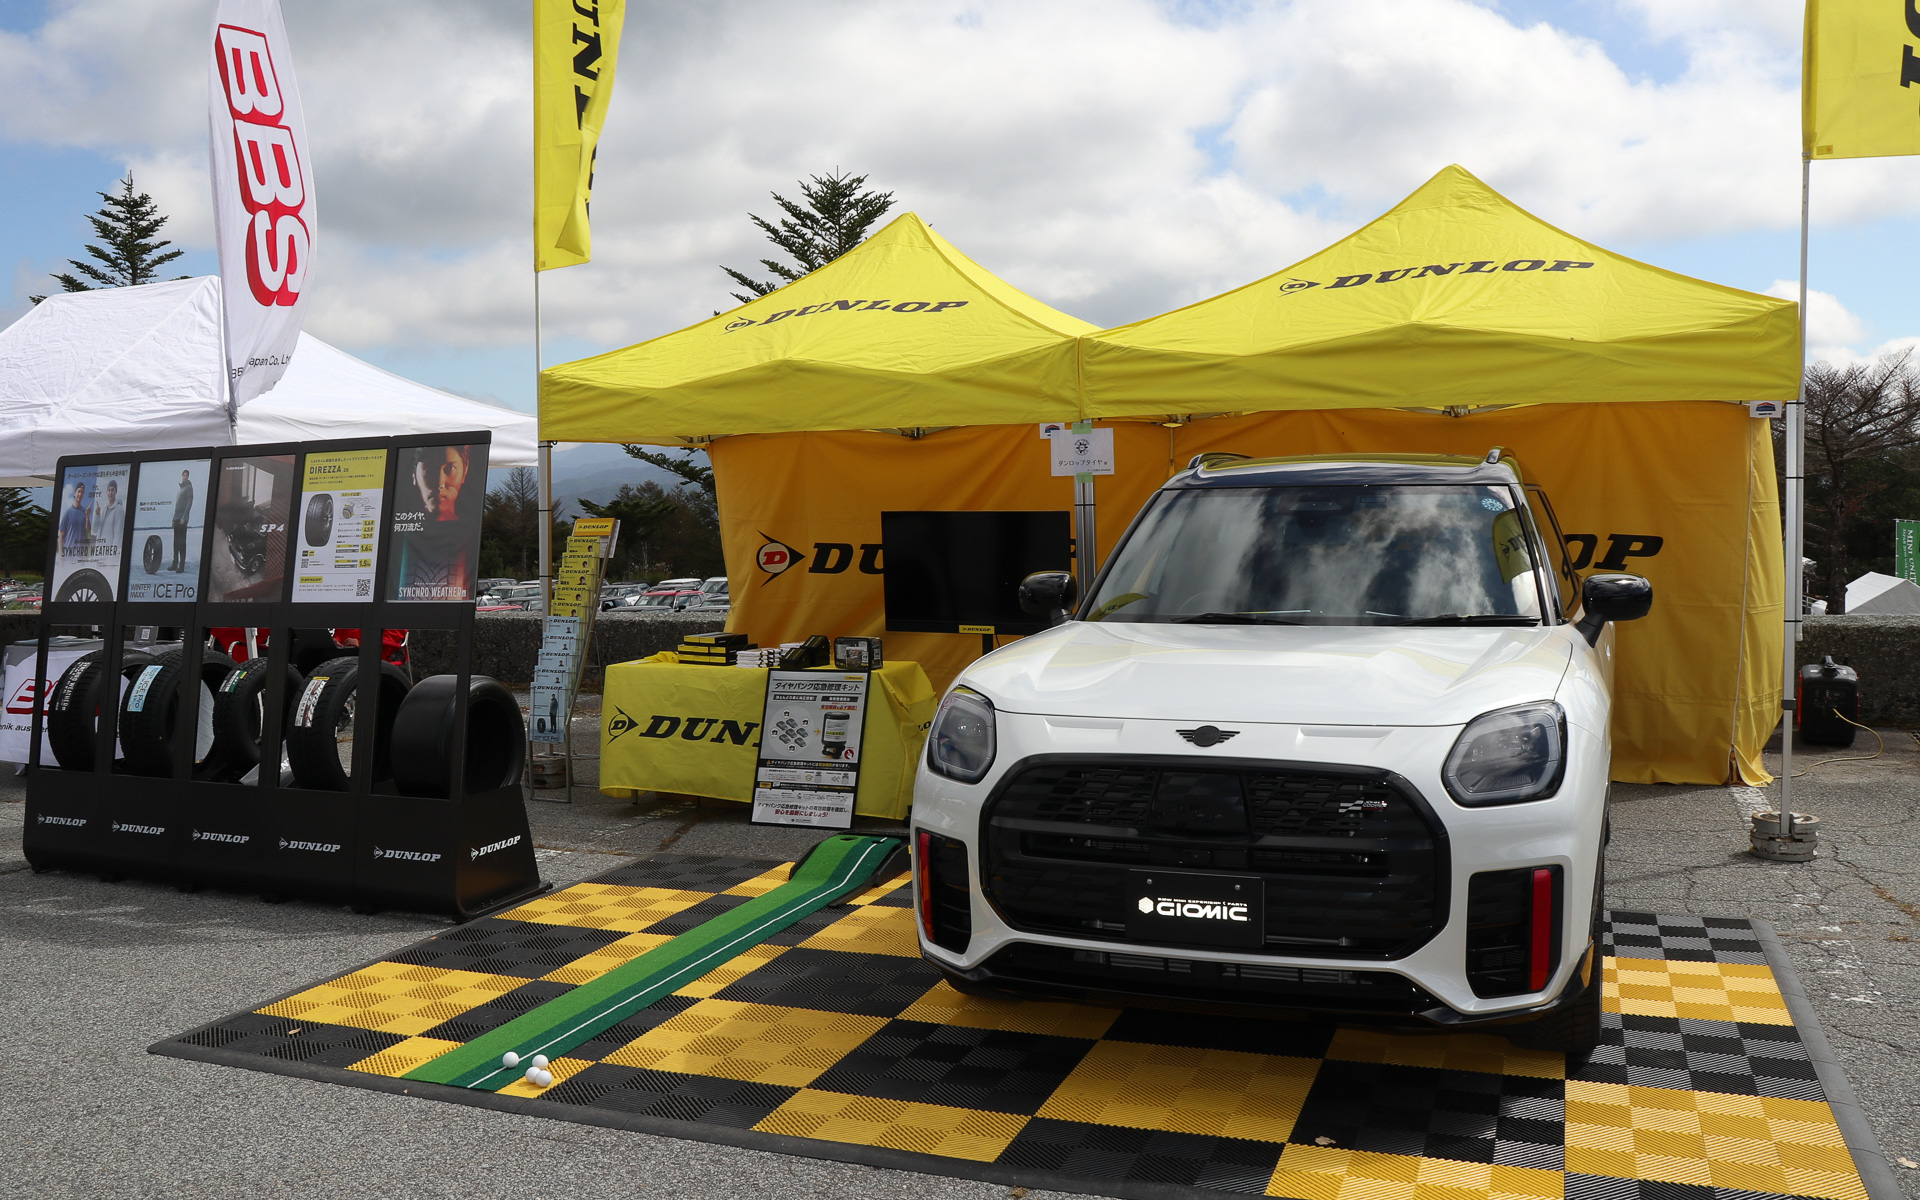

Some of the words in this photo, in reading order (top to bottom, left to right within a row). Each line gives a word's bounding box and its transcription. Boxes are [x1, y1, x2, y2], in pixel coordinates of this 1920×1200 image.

[215, 24, 310, 307] BBS
[1323, 259, 1595, 290] DUNLOP
[756, 299, 969, 327] DUNLOP
[248, 357, 268, 368] apan
[281, 354, 292, 365] Lt
[309, 465, 342, 475] DIREZZA
[259, 523, 285, 533] SP4
[90, 544, 118, 556] WEATHER
[153, 584, 173, 599] ICE
[175, 584, 195, 599] Pro
[398, 586, 429, 598] SYNCHRO
[431, 586, 462, 598] WEATHER
[44, 816, 87, 827] DUNLOP
[119, 823, 165, 836] DUNLOP
[200, 832, 250, 844] DUNLOP
[288, 840, 341, 853] DUNLOP
[478, 834, 521, 857] DUNLOP
[383, 849, 442, 863] DUNLOP
[1156, 901, 1248, 922] GIOMIC
